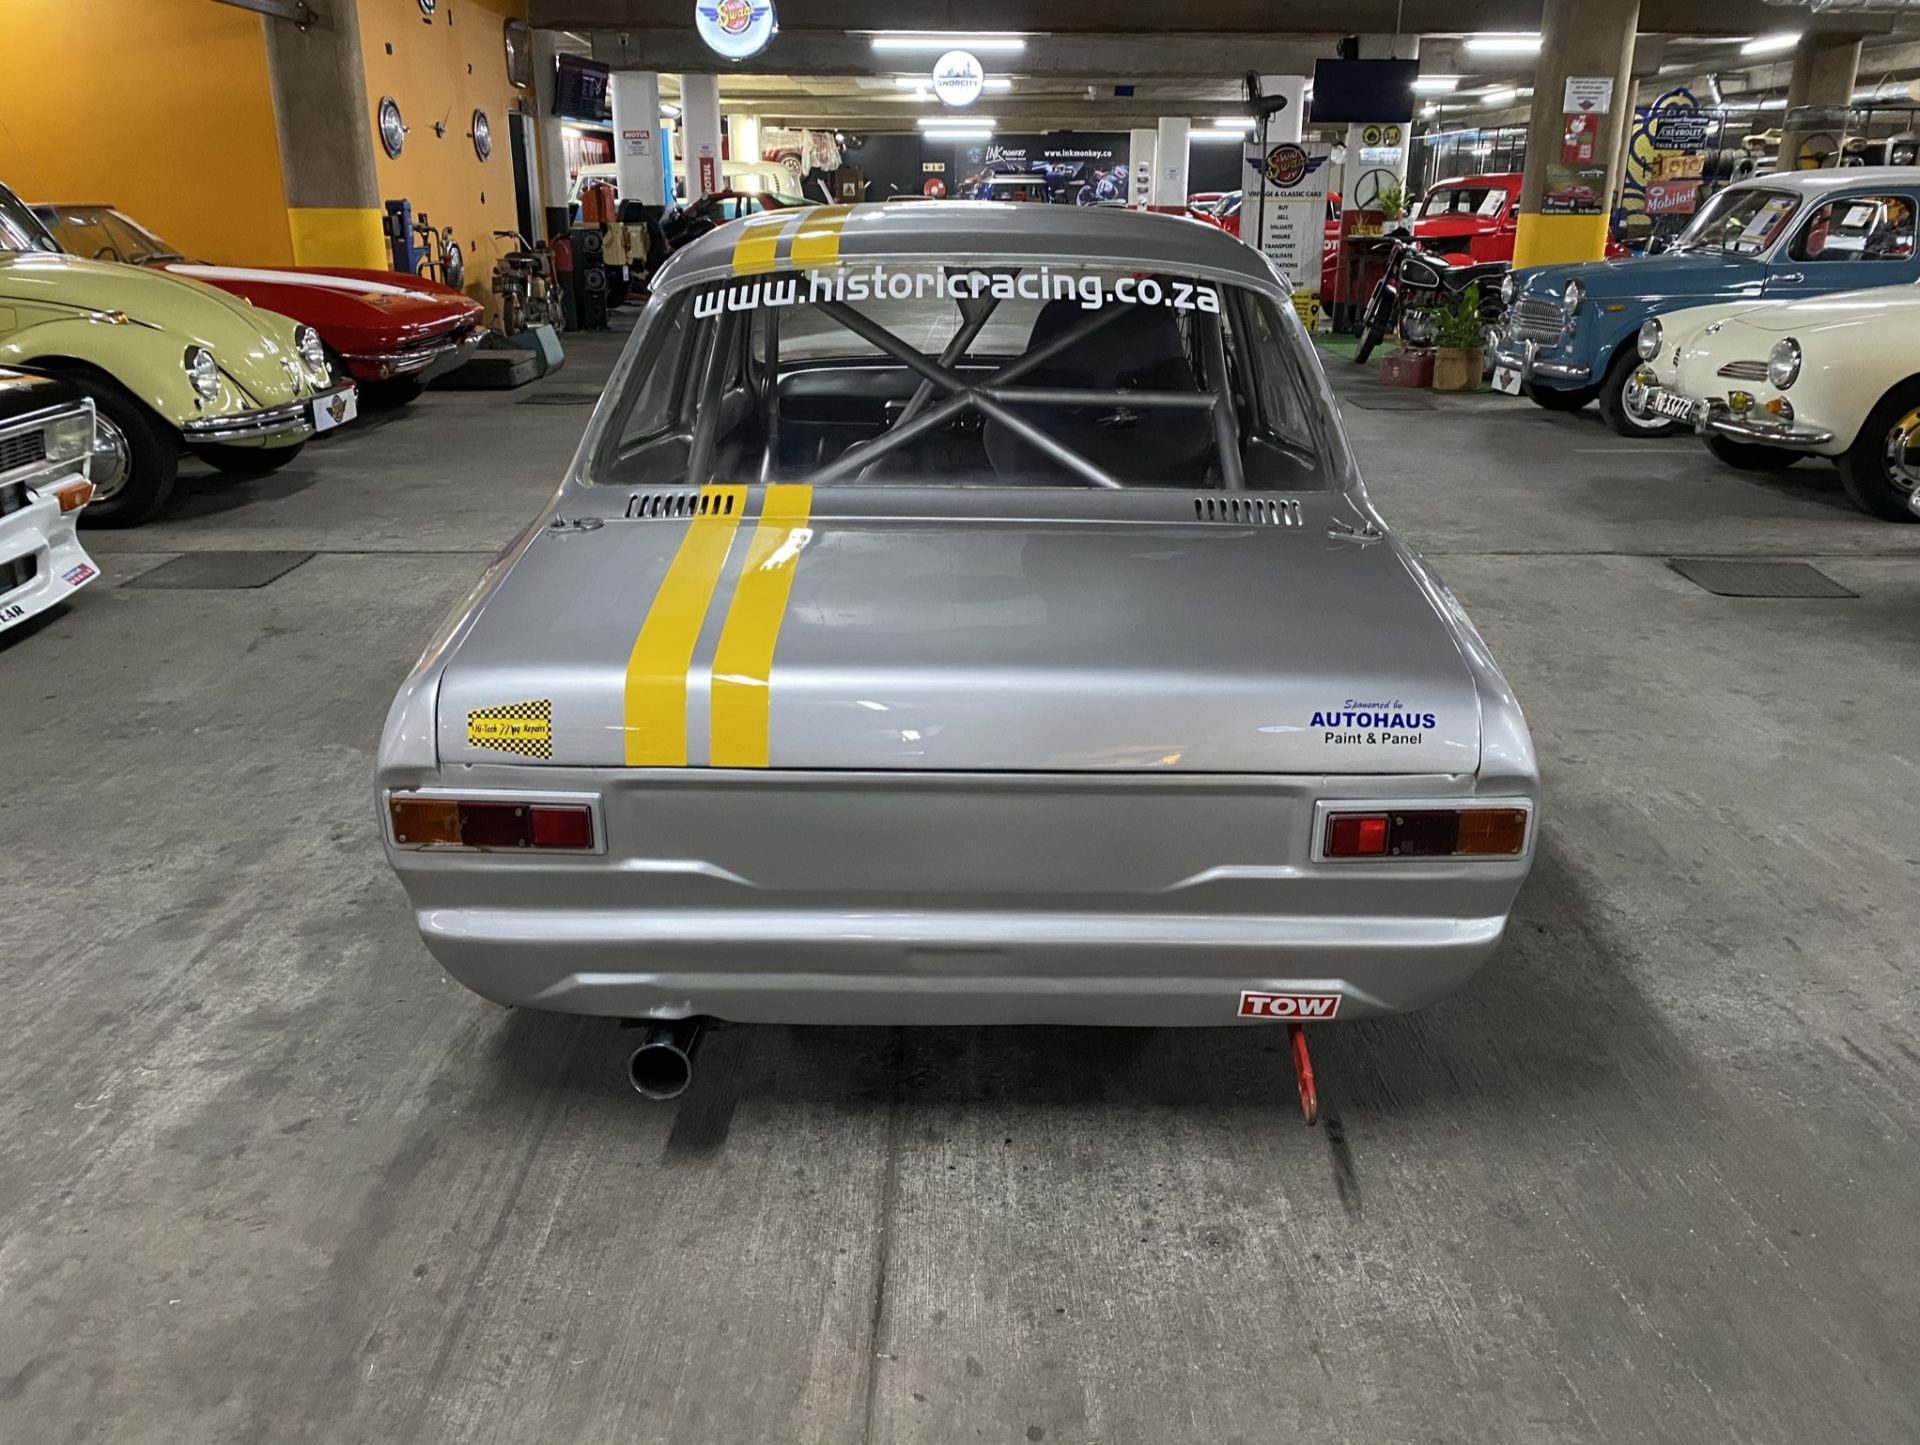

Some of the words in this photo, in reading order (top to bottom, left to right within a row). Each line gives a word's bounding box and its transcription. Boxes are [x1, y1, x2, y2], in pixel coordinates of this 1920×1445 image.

[937, 79, 979, 87] SNORCITY
[1662, 128, 1702, 137] CHEVROLET
[985, 145, 1004, 161] INK
[1044, 149, 1112, 159] www.inkmonkey.co
[1647, 187, 1696, 212] Mobiloil
[694, 266, 1220, 319] www.historicracing.co.za
[1343, 699, 1391, 710] Sponsored
[1393, 700, 1403, 709] by
[1310, 711, 1436, 729] AUTOHAUS
[474, 724, 497, 733] Hi-Tech
[523, 724, 546, 734] Repairs
[1325, 732, 1362, 744] Paint
[1366, 732, 1376, 744] &
[1382, 732, 1422, 744] Panel
[1247, 997, 1334, 1015] TOW
